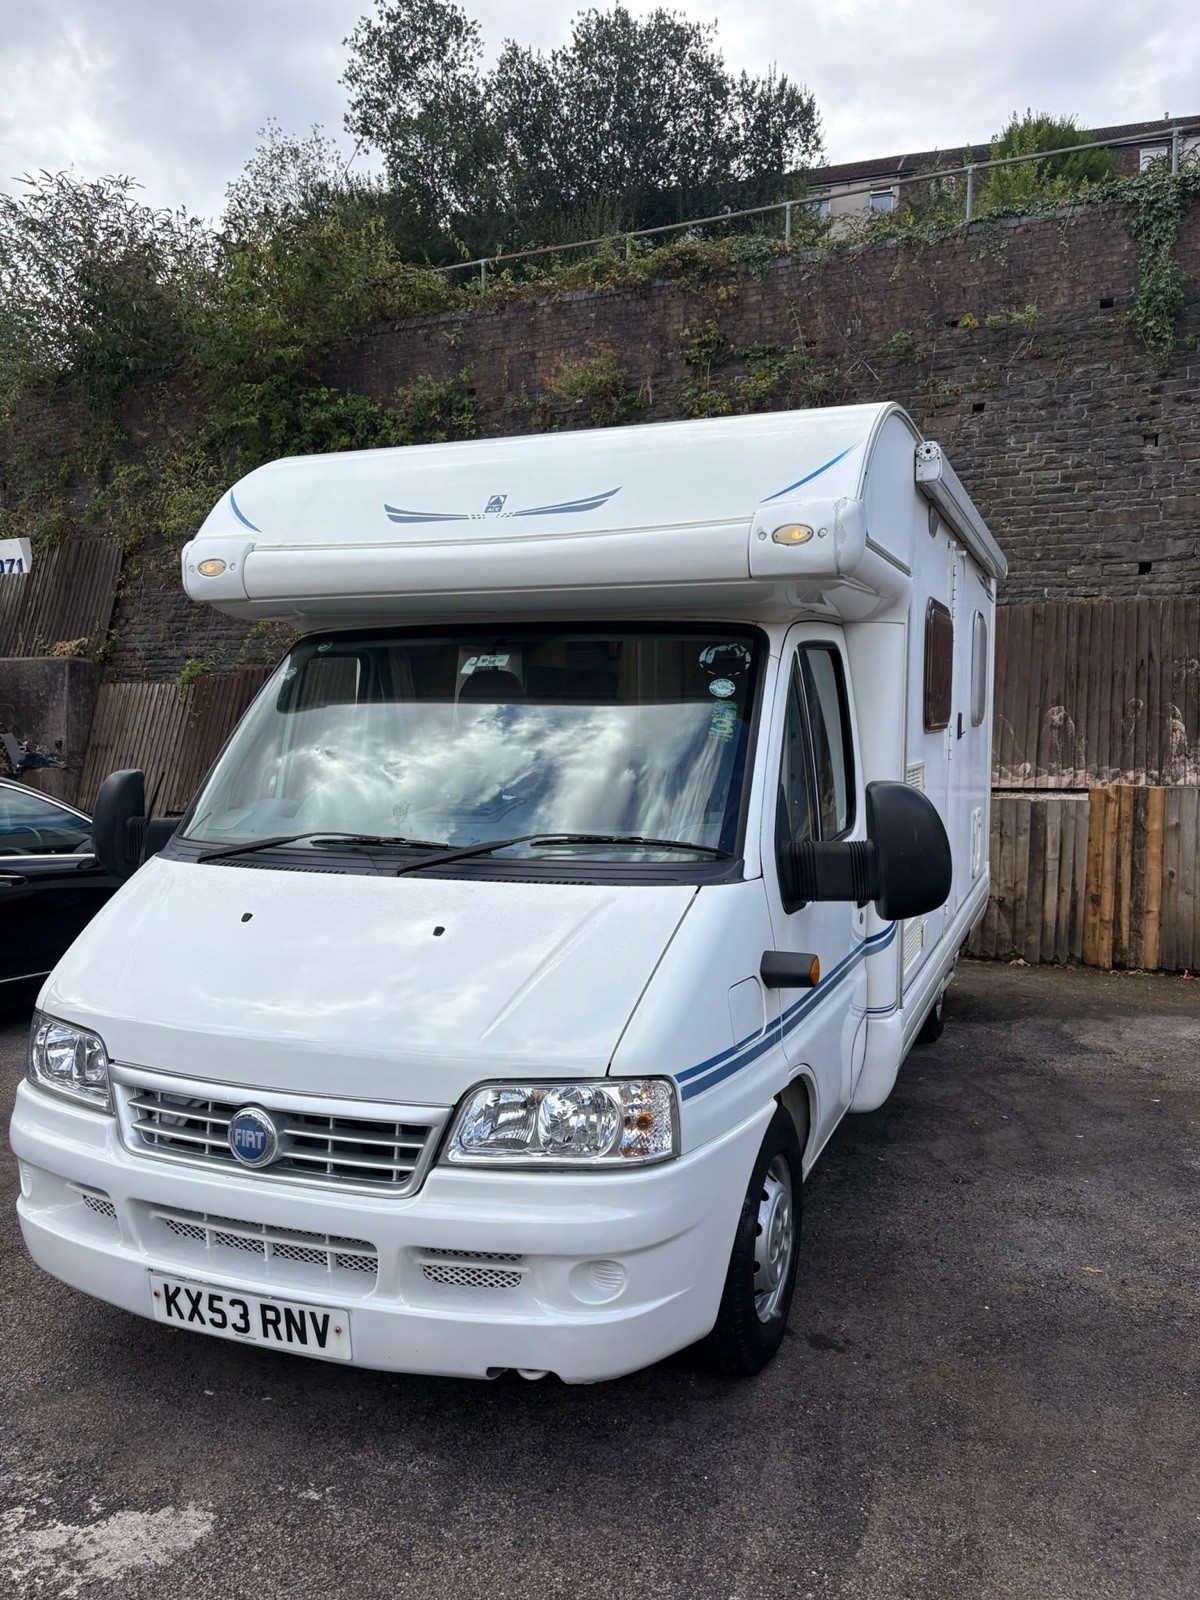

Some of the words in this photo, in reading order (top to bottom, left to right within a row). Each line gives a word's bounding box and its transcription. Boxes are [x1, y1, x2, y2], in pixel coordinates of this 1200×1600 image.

[234, 1128, 264, 1149] FIAT
[163, 1283, 250, 1334] KX53
[260, 1303, 330, 1348] RNV
